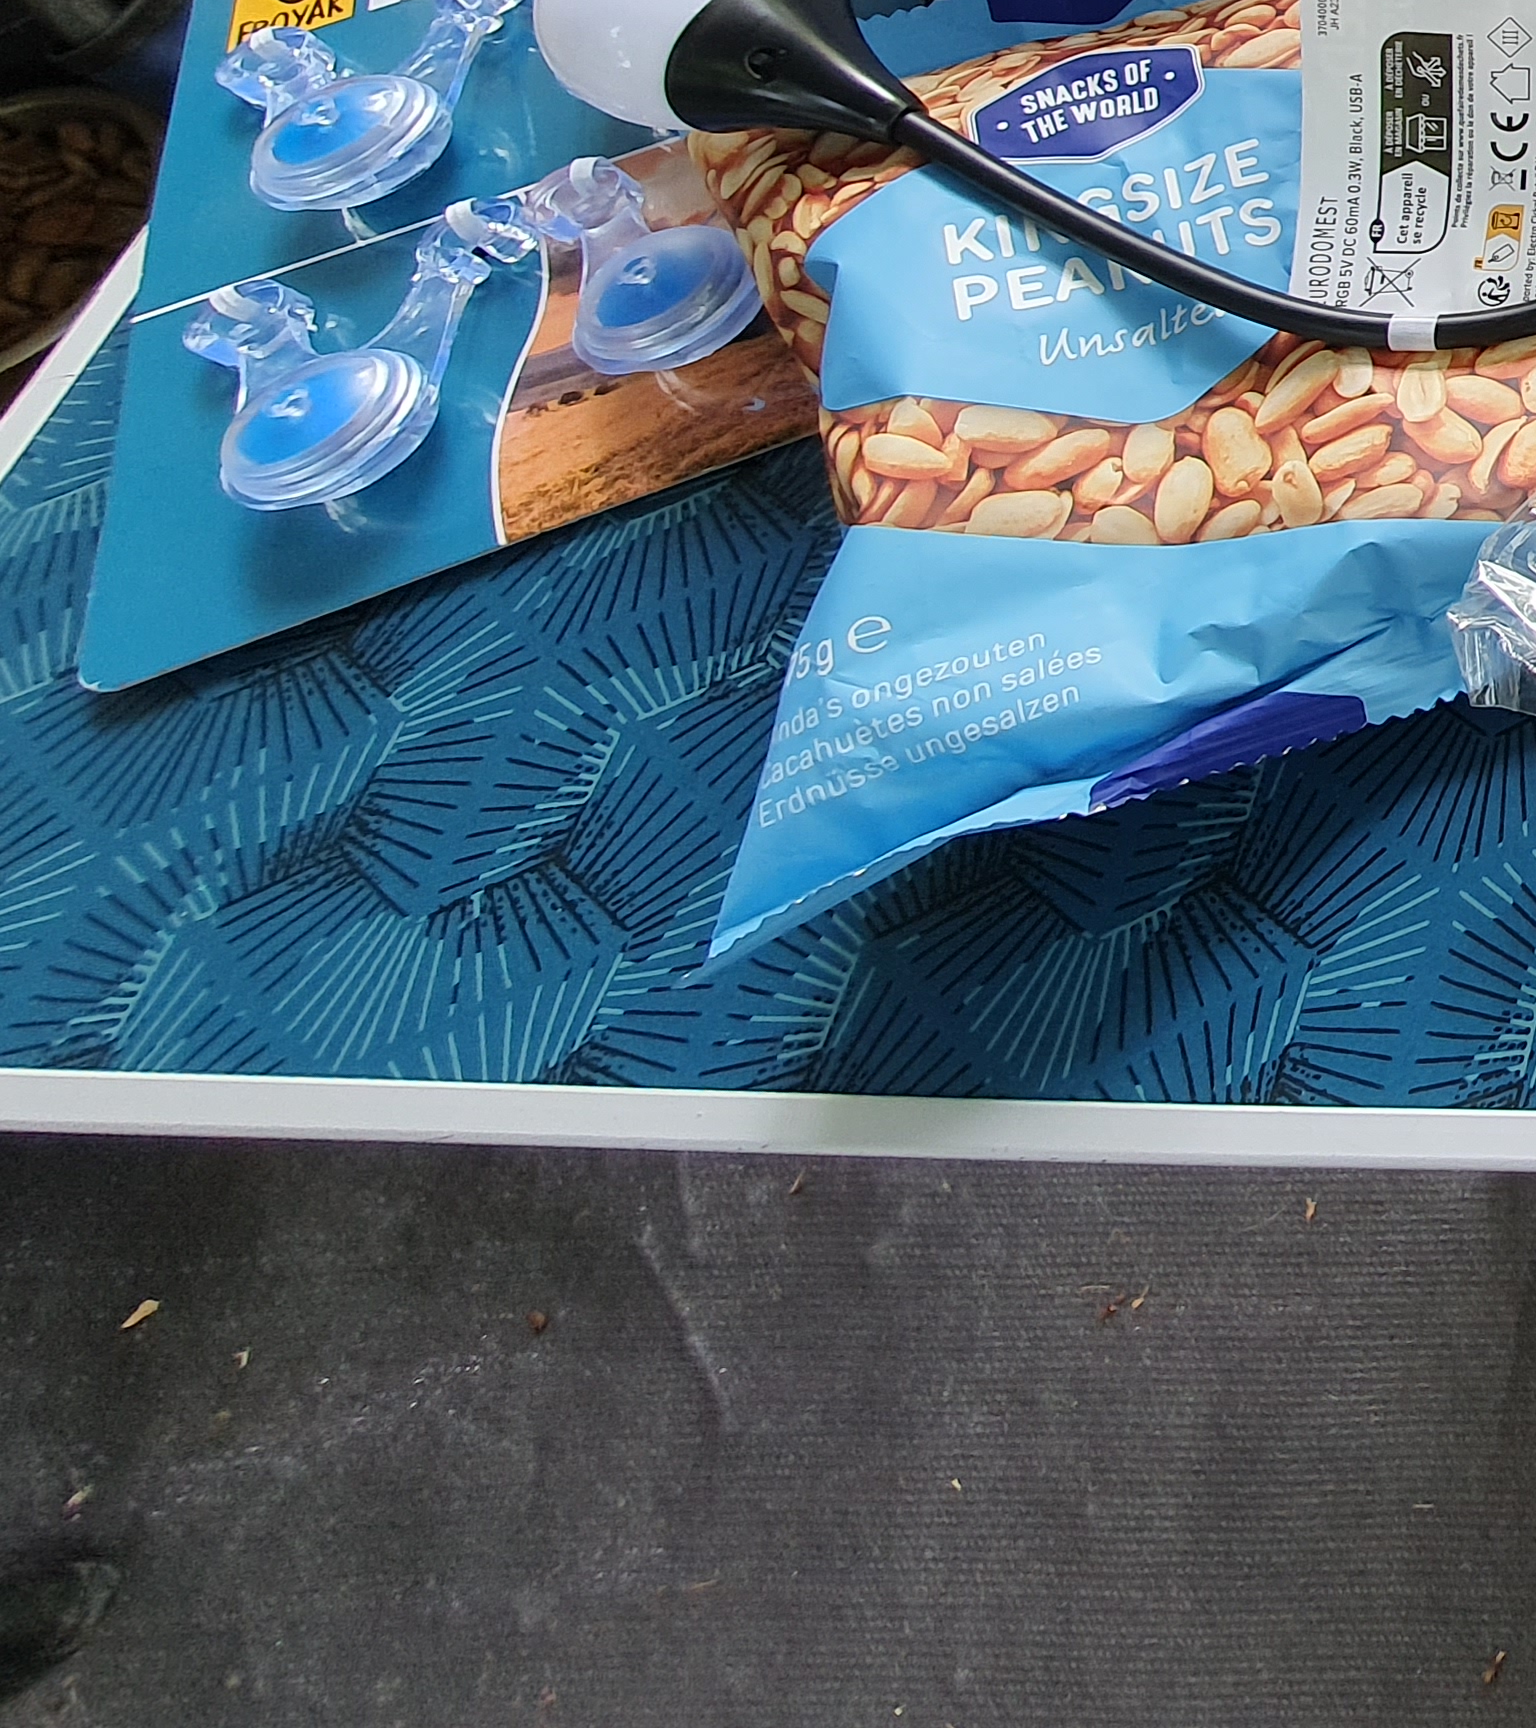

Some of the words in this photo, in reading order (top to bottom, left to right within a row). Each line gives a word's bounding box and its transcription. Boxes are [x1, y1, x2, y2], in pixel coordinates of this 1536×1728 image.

[1330, 18, 1339, 30] JH
[1020, 68, 1118, 114] SNACKS
[1124, 59, 1152, 87] OF
[1350, 74, 1363, 113] USB-A
[1021, 110, 1069, 145] THE
[1073, 87, 1160, 125] WORLD
[1350, 117, 1364, 154] Black,
[1347, 158, 1363, 194] 0.3W,
[1345, 197, 1360, 234] 60mA
[1400, 173, 1414, 222] appareil
[1414, 187, 1428, 228] recycle
[1342, 238, 1356, 257] DC
[1371, 224, 1382, 238] FR
[1396, 224, 1408, 244] Cet
[1412, 232, 1421, 244] se
[1340, 260, 1354, 277] 5V
[1526, 258, 1536, 271] by:
[1335, 281, 1351, 307] RGB
[1523, 274, 1533, 301] ported
[1039, 302, 1228, 367] Unsalte
[776, 693, 845, 744] nda's
[851, 630, 1048, 710] ongezouten
[931, 681, 993, 719] non
[1000, 643, 1103, 693] salées
[758, 750, 901, 830] Erdnüsse
[904, 683, 1082, 766] ungesalzen
